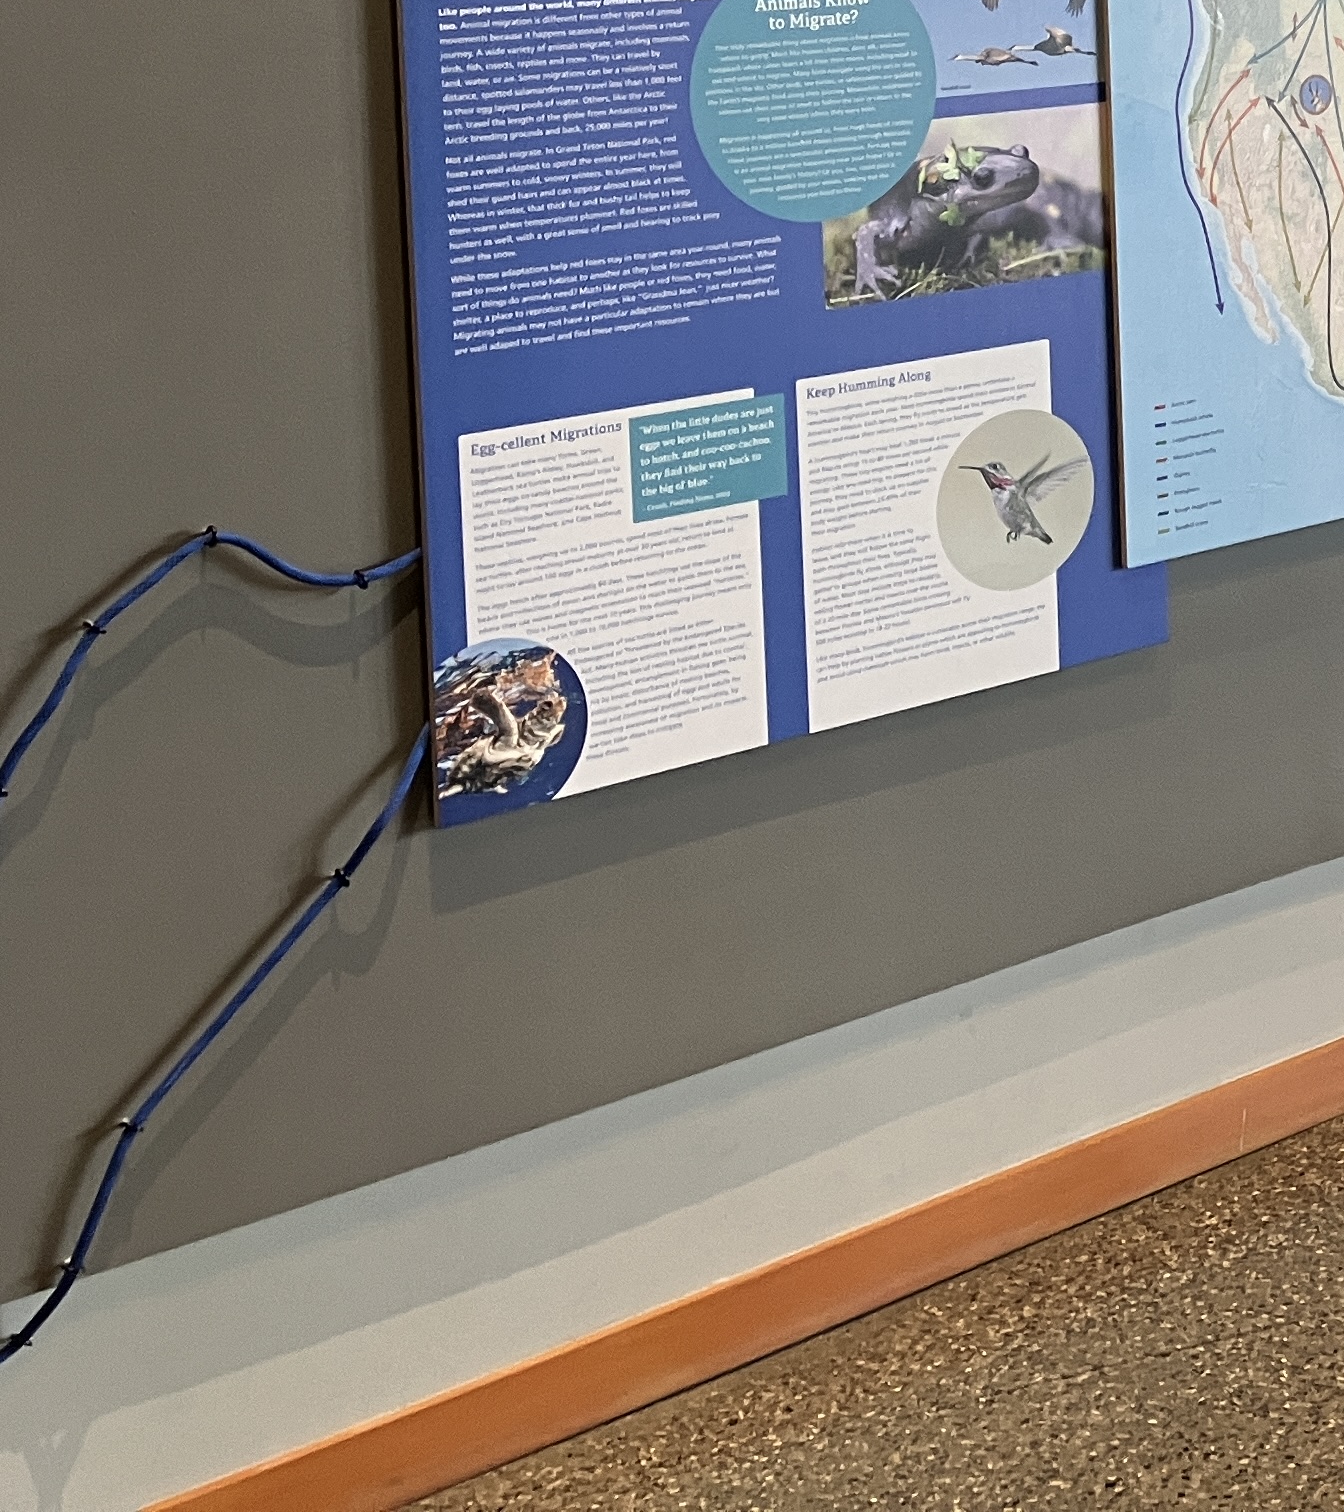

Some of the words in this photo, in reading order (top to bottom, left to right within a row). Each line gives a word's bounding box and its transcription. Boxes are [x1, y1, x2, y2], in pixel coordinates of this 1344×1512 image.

[769, 15, 785, 30] to
[789, 10, 859, 30] Migrate?
[806, 382, 835, 399] Keep
[838, 376, 896, 394] Humming
[898, 370, 931, 384] Along
[470, 433, 546, 457] Egg-cellent
[550, 421, 622, 444] Migrations
